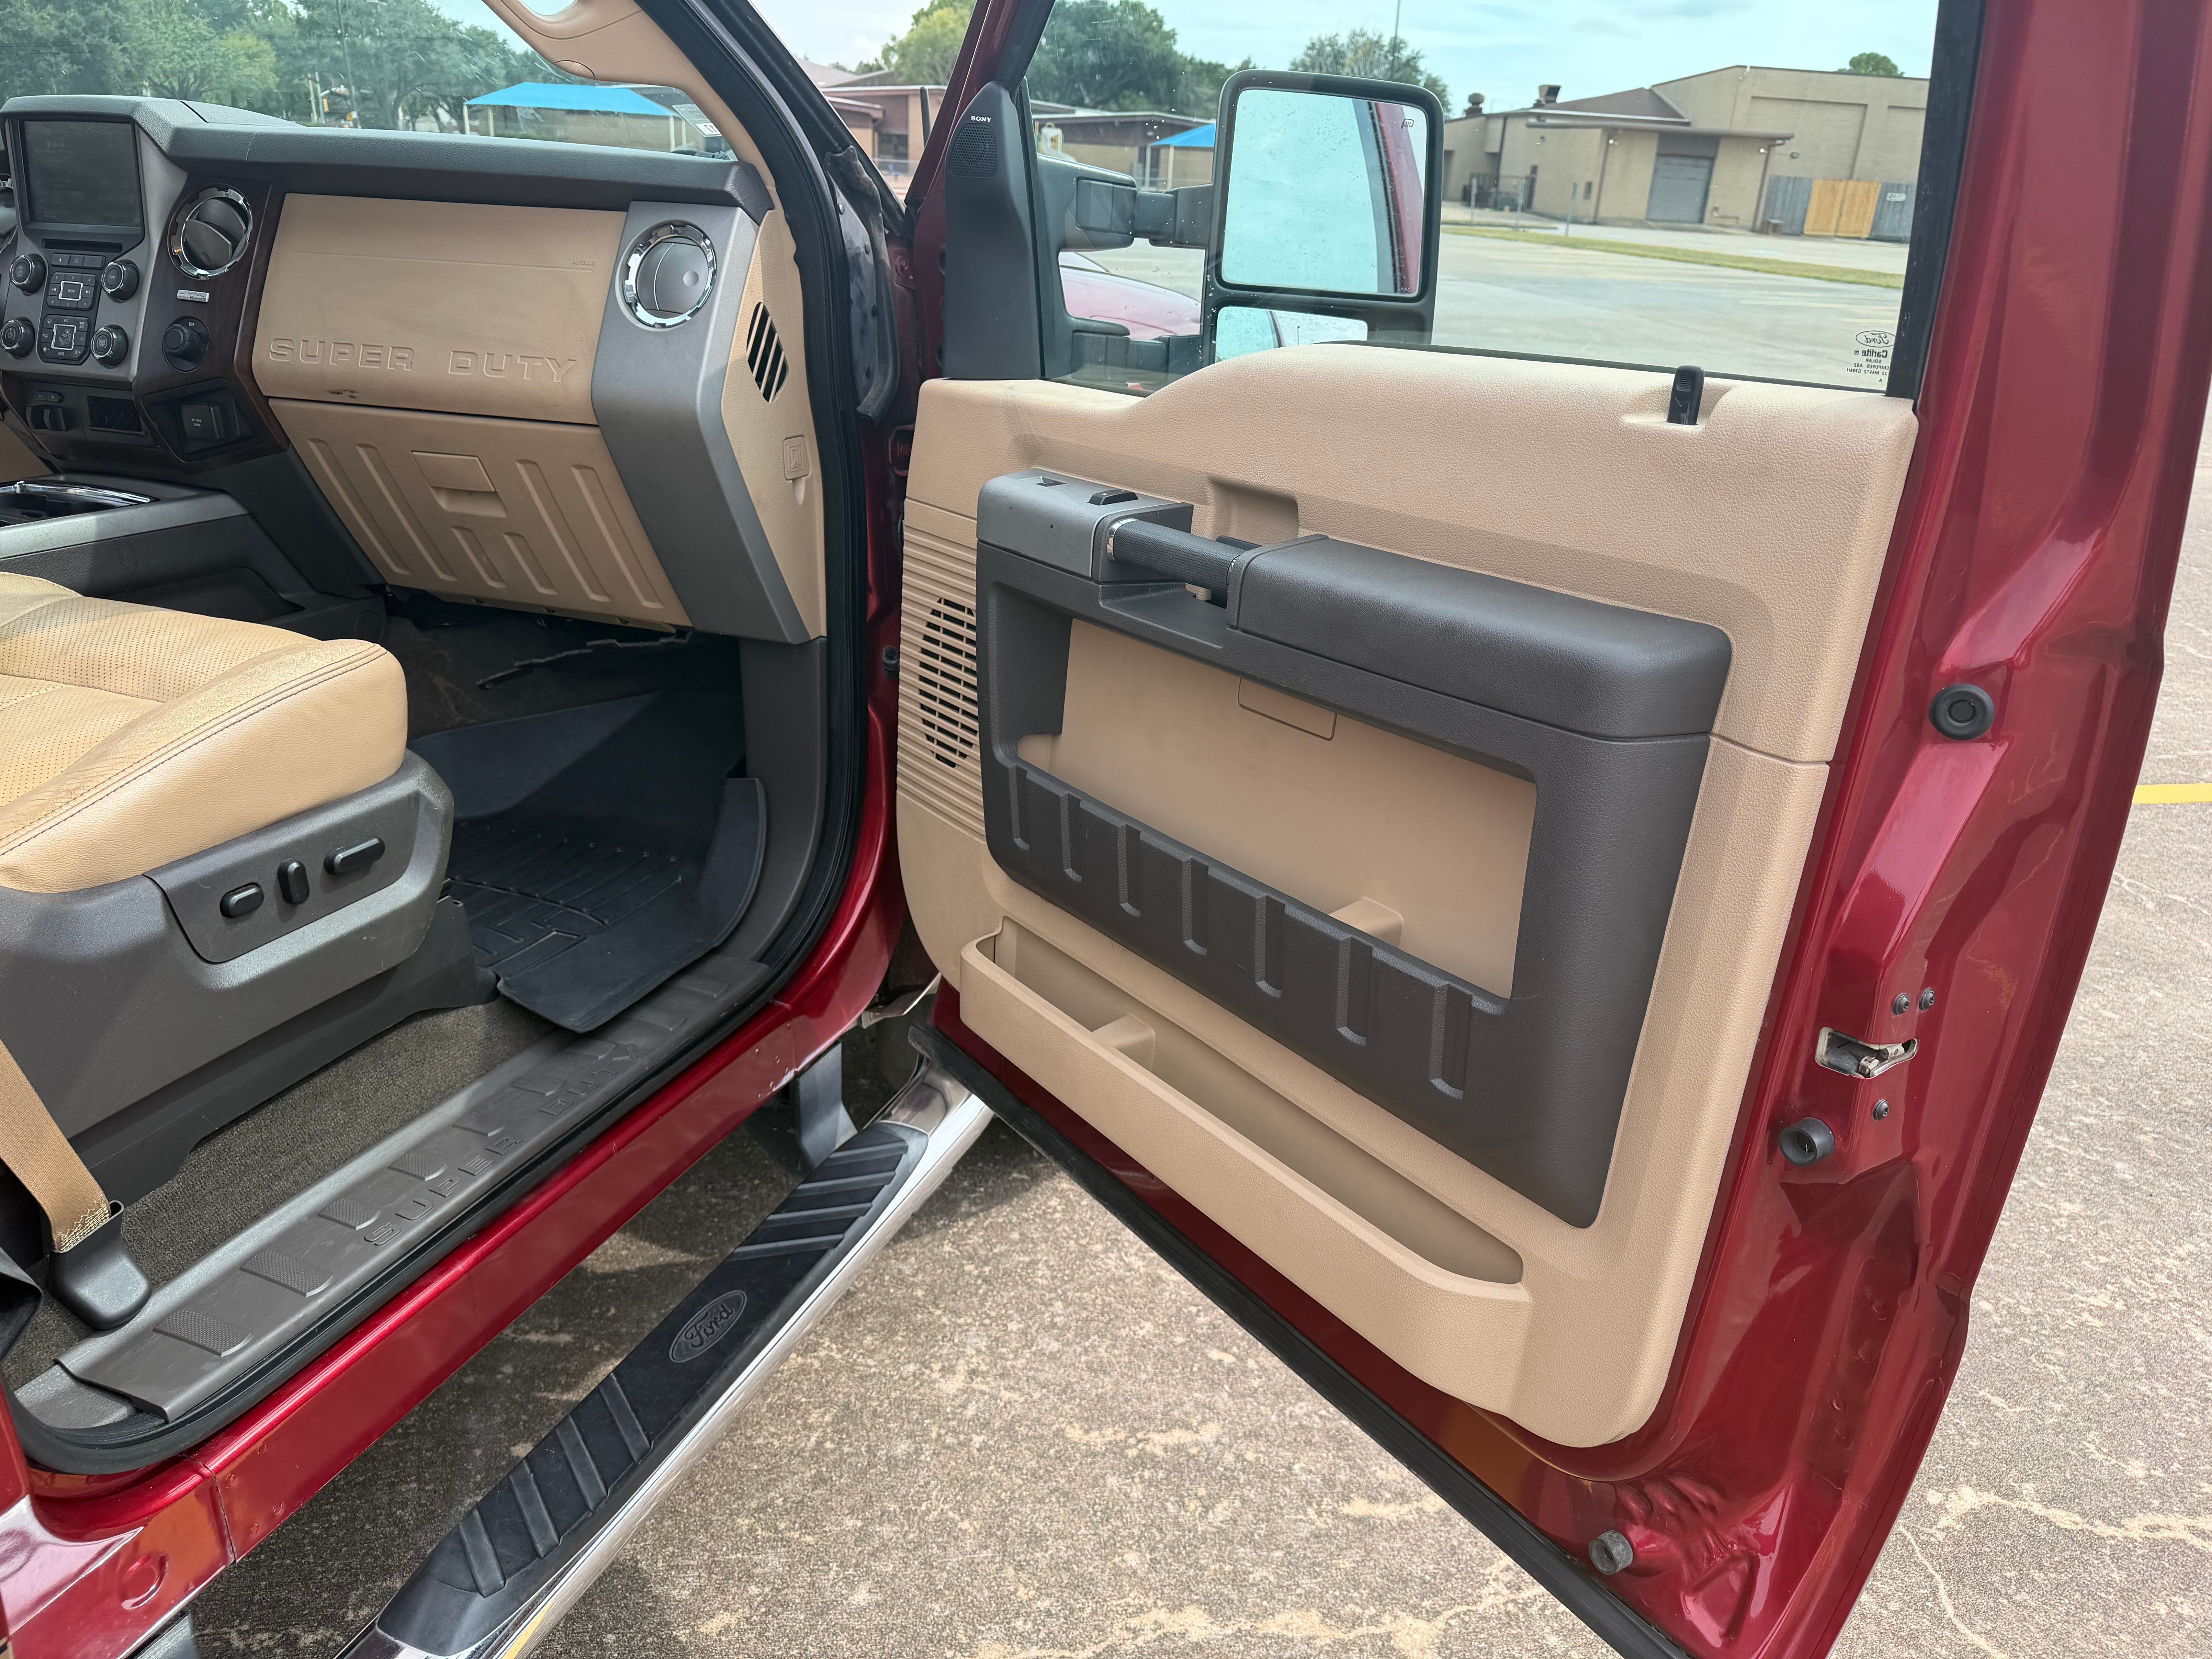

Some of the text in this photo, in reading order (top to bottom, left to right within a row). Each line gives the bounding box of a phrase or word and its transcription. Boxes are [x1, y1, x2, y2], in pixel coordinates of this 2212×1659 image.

[269, 337, 577, 383] SUPER DUTY
[364, 1043, 641, 1246] SUPER DUTY
[684, 1303, 733, 1349] Ford
